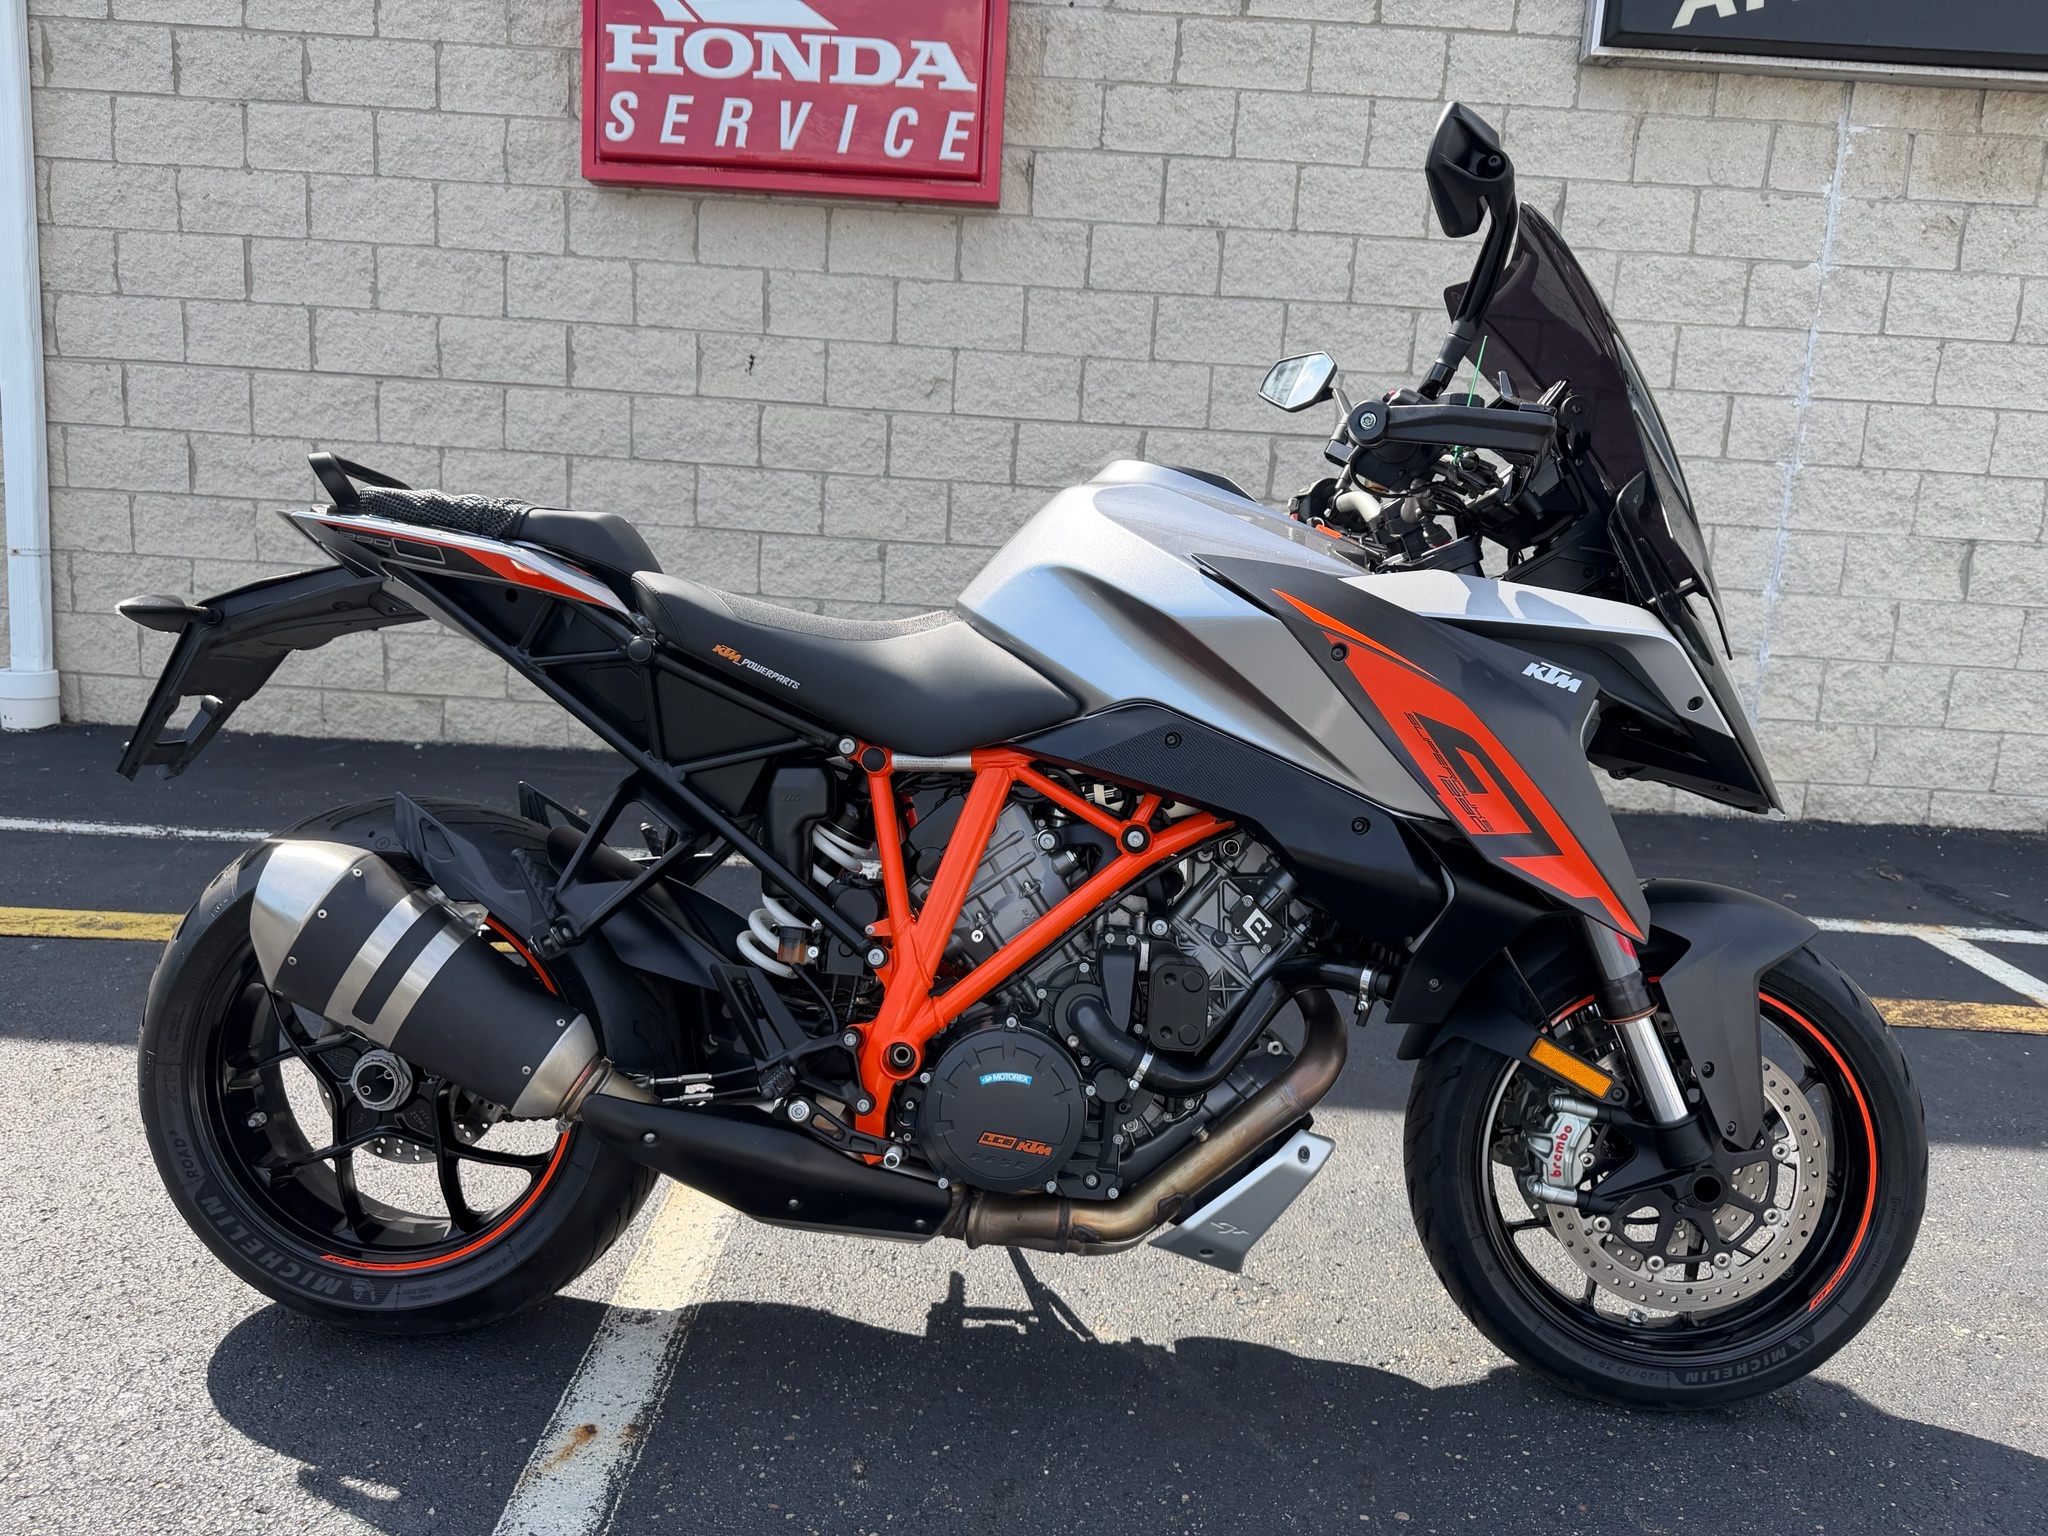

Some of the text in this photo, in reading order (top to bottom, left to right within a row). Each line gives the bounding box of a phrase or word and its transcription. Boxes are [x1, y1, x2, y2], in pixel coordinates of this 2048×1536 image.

[605, 24, 977, 92] HONDA
[605, 91, 975, 162] SERVICE
[1522, 661, 1582, 694] KTM
[992, 1072, 1029, 1083] MOTOREX
[1015, 1139, 1053, 1156] KTM
[1550, 1125, 1573, 1178] brembo
[201, 1195, 343, 1295] MICHELIN
[1684, 1346, 1788, 1383] MICHELIN
